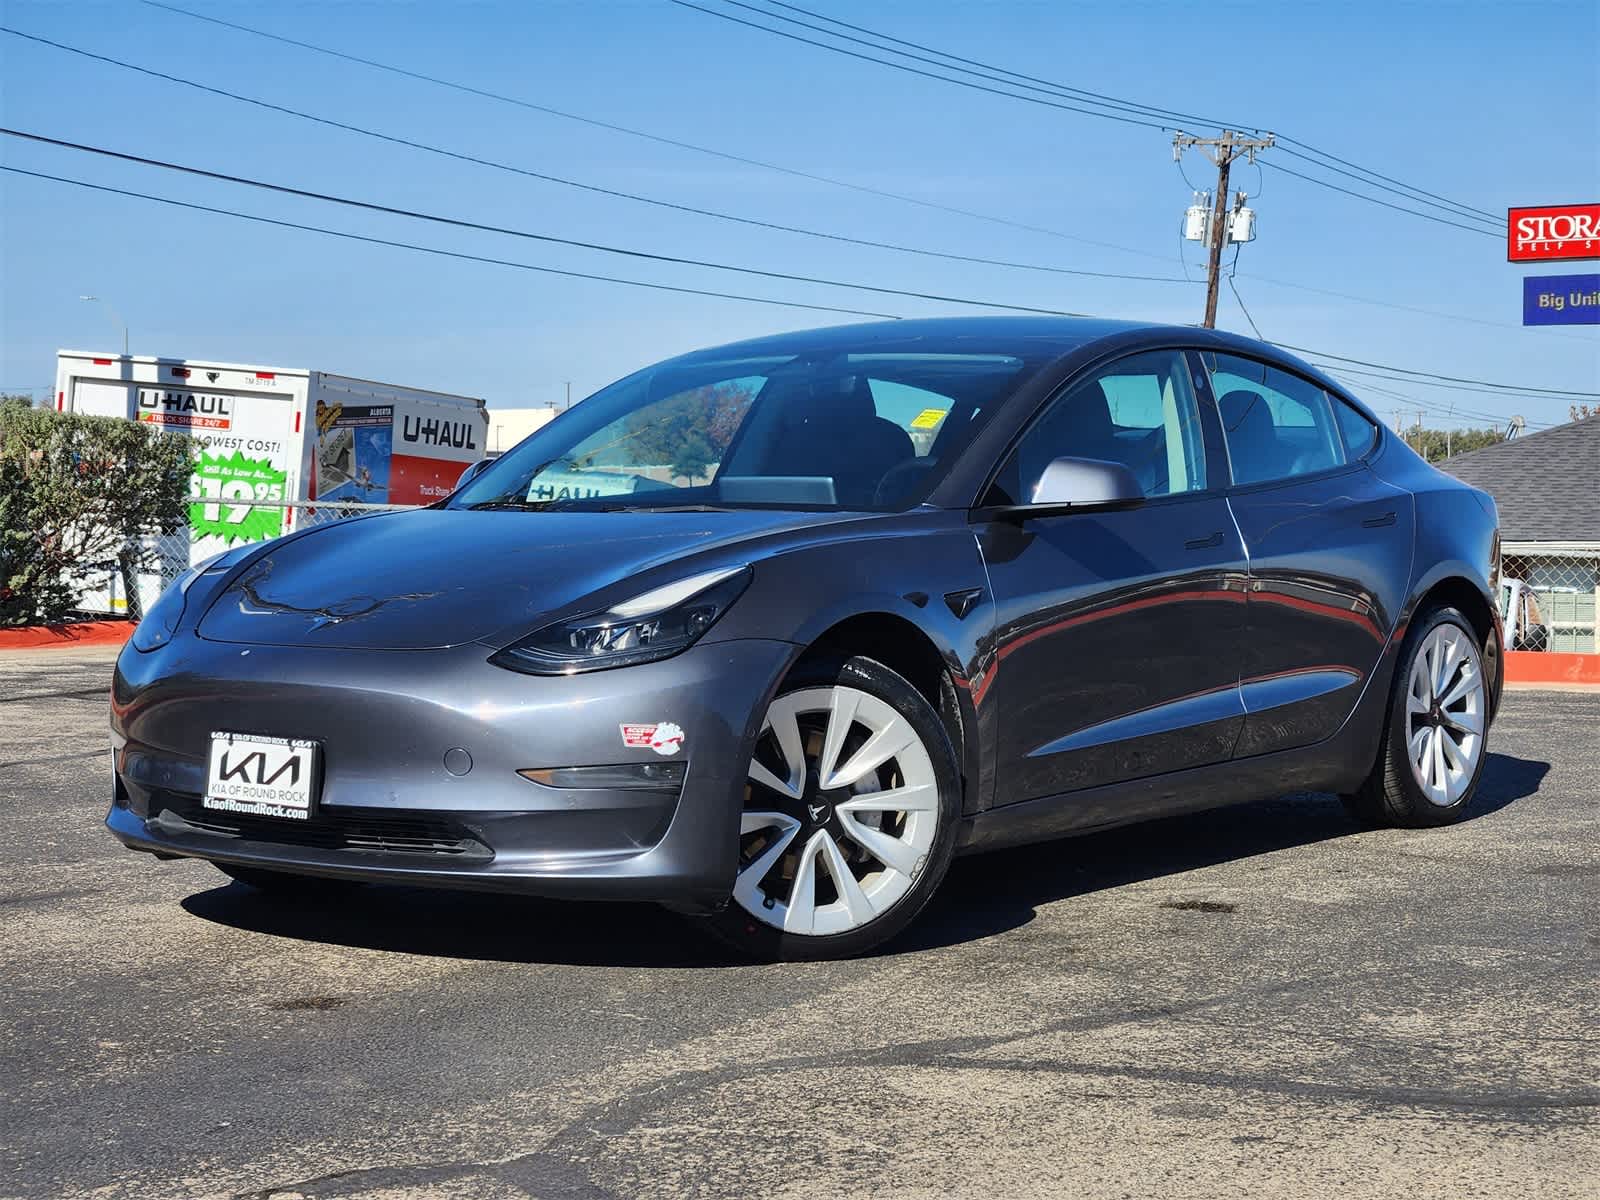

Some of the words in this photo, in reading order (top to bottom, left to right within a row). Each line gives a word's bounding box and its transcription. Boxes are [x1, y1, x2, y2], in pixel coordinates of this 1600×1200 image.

[1517, 241, 1564, 251] SELF
[1539, 293, 1565, 311] Big
[139, 391, 230, 416] U-HAUL
[370, 407, 391, 416] ALBERTA
[152, 413, 177, 424] TRUCK
[177, 416, 203, 426] SHARE
[204, 418, 222, 428] 24/7
[404, 415, 476, 450] U-HAUL
[247, 439, 281, 453] COST!
[219, 750, 301, 787] KIA
[211, 784, 227, 795] KIA
[229, 785, 241, 796] OF
[243, 786, 276, 800] ROUND
[278, 789, 306, 803] ROCK
[203, 796, 308, 820] KiaofRoundRock.com
